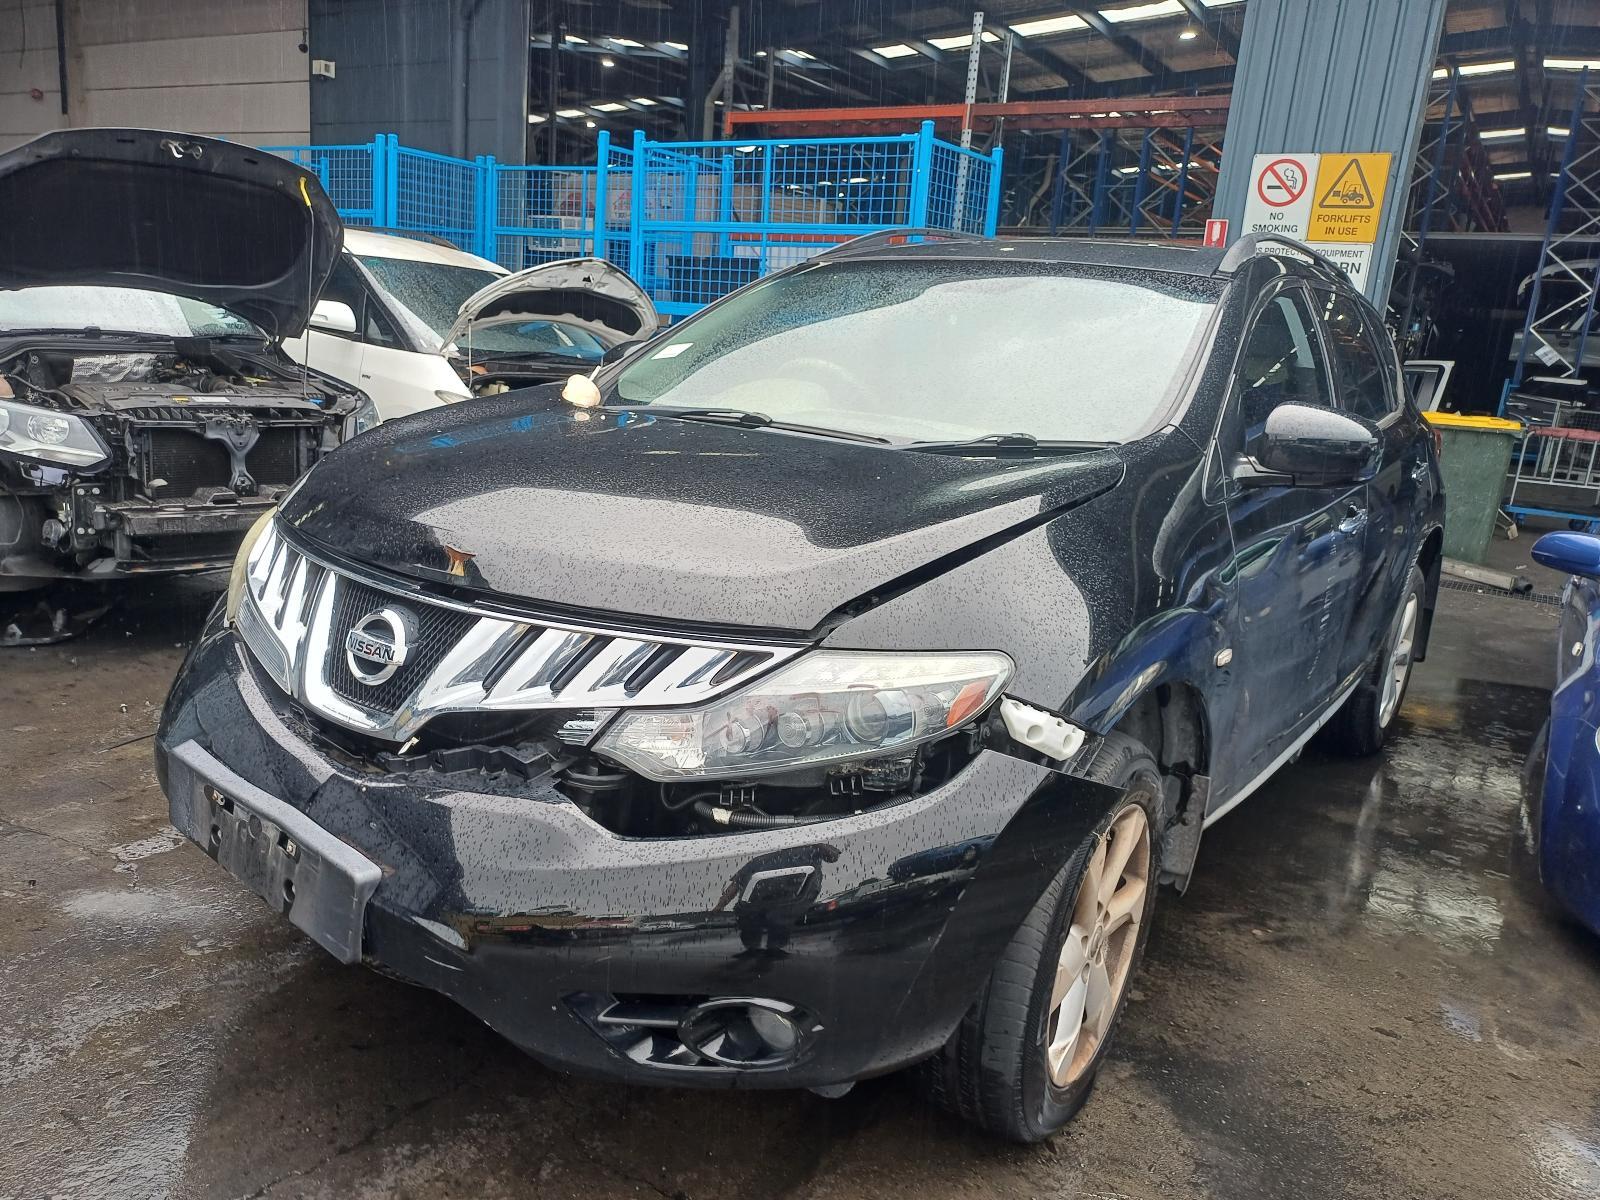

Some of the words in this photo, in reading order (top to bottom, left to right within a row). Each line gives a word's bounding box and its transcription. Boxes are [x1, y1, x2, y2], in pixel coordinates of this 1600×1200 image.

[1269, 212, 1284, 221] NO
[1316, 214, 1371, 223] FORKLIFTS
[1252, 224, 1298, 233] SMOKING
[1325, 226, 1337, 235] IN
[1338, 227, 1358, 236] USE
[348, 634, 396, 661] NISSAN
